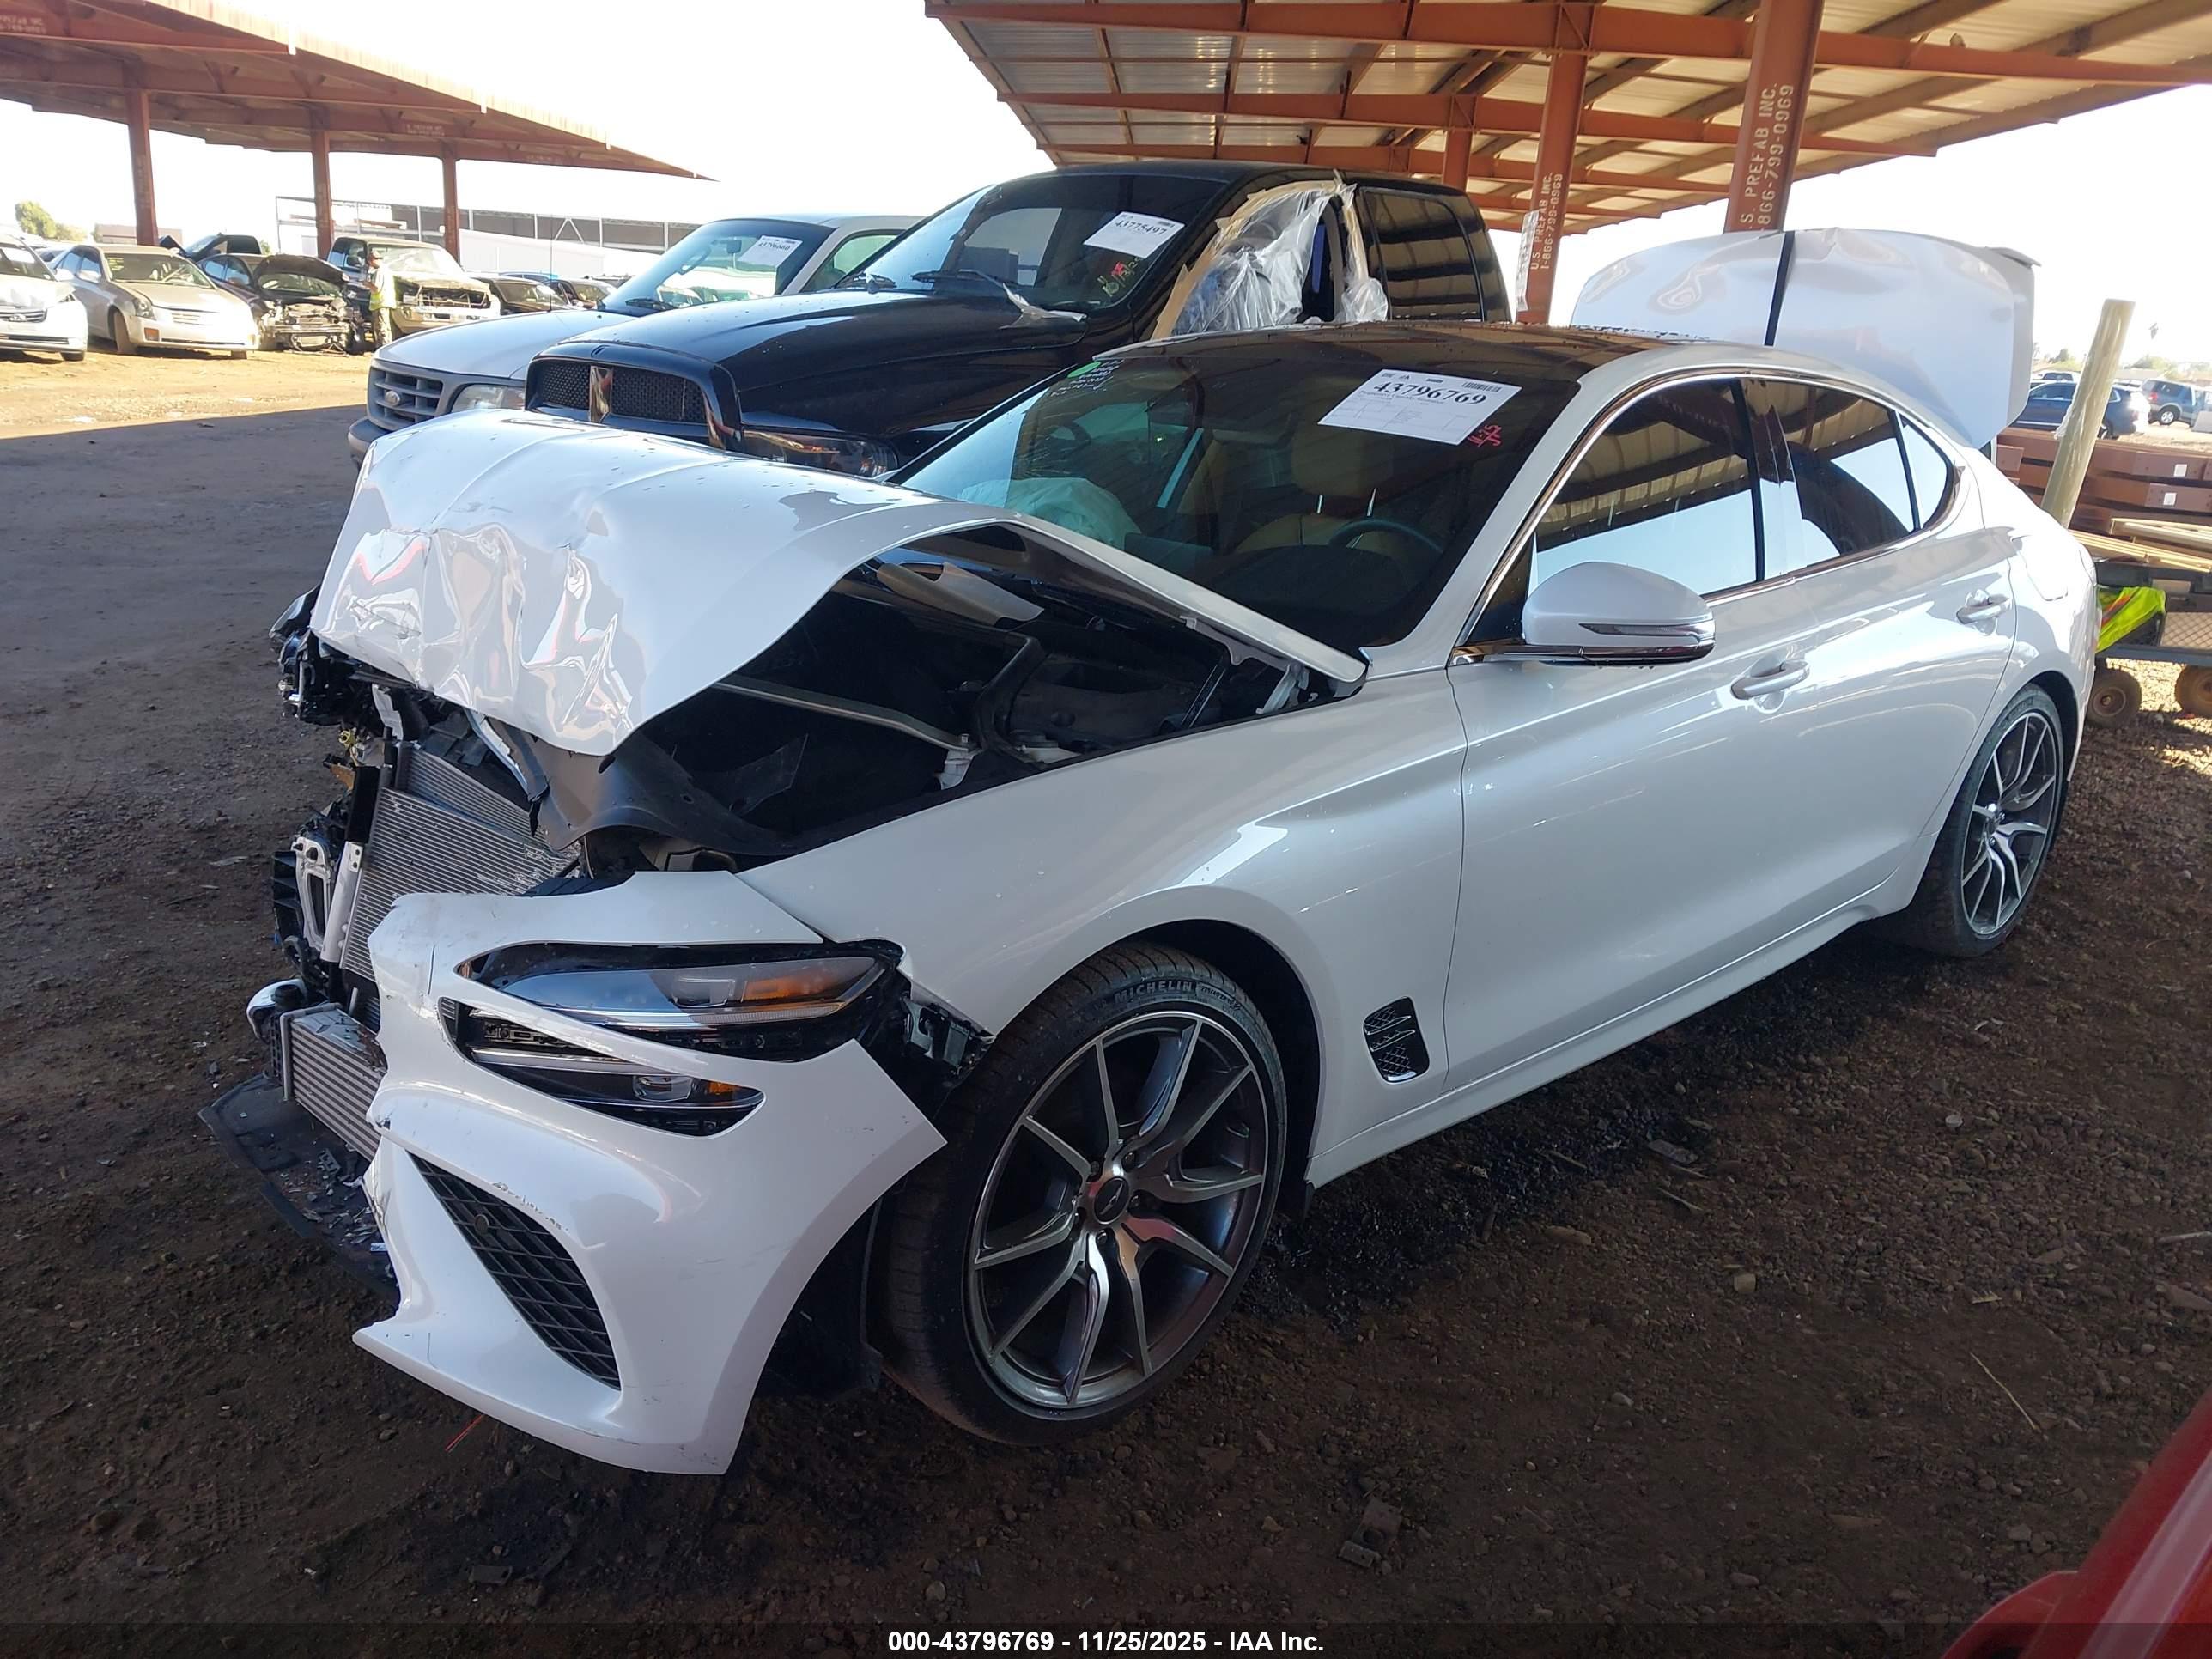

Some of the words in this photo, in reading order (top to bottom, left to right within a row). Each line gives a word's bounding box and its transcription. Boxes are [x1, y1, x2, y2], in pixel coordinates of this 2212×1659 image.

[1744, 127, 1769, 198] PREFAB
[1759, 82, 1778, 118] INC.
[1757, 84, 1794, 230] -866-799-0969
[1115, 219, 1167, 235] 43775497
[1534, 199, 1548, 243] PREFAB
[1373, 381, 1487, 405] 43796769
[1114, 981, 1193, 1003] MICHELIN
